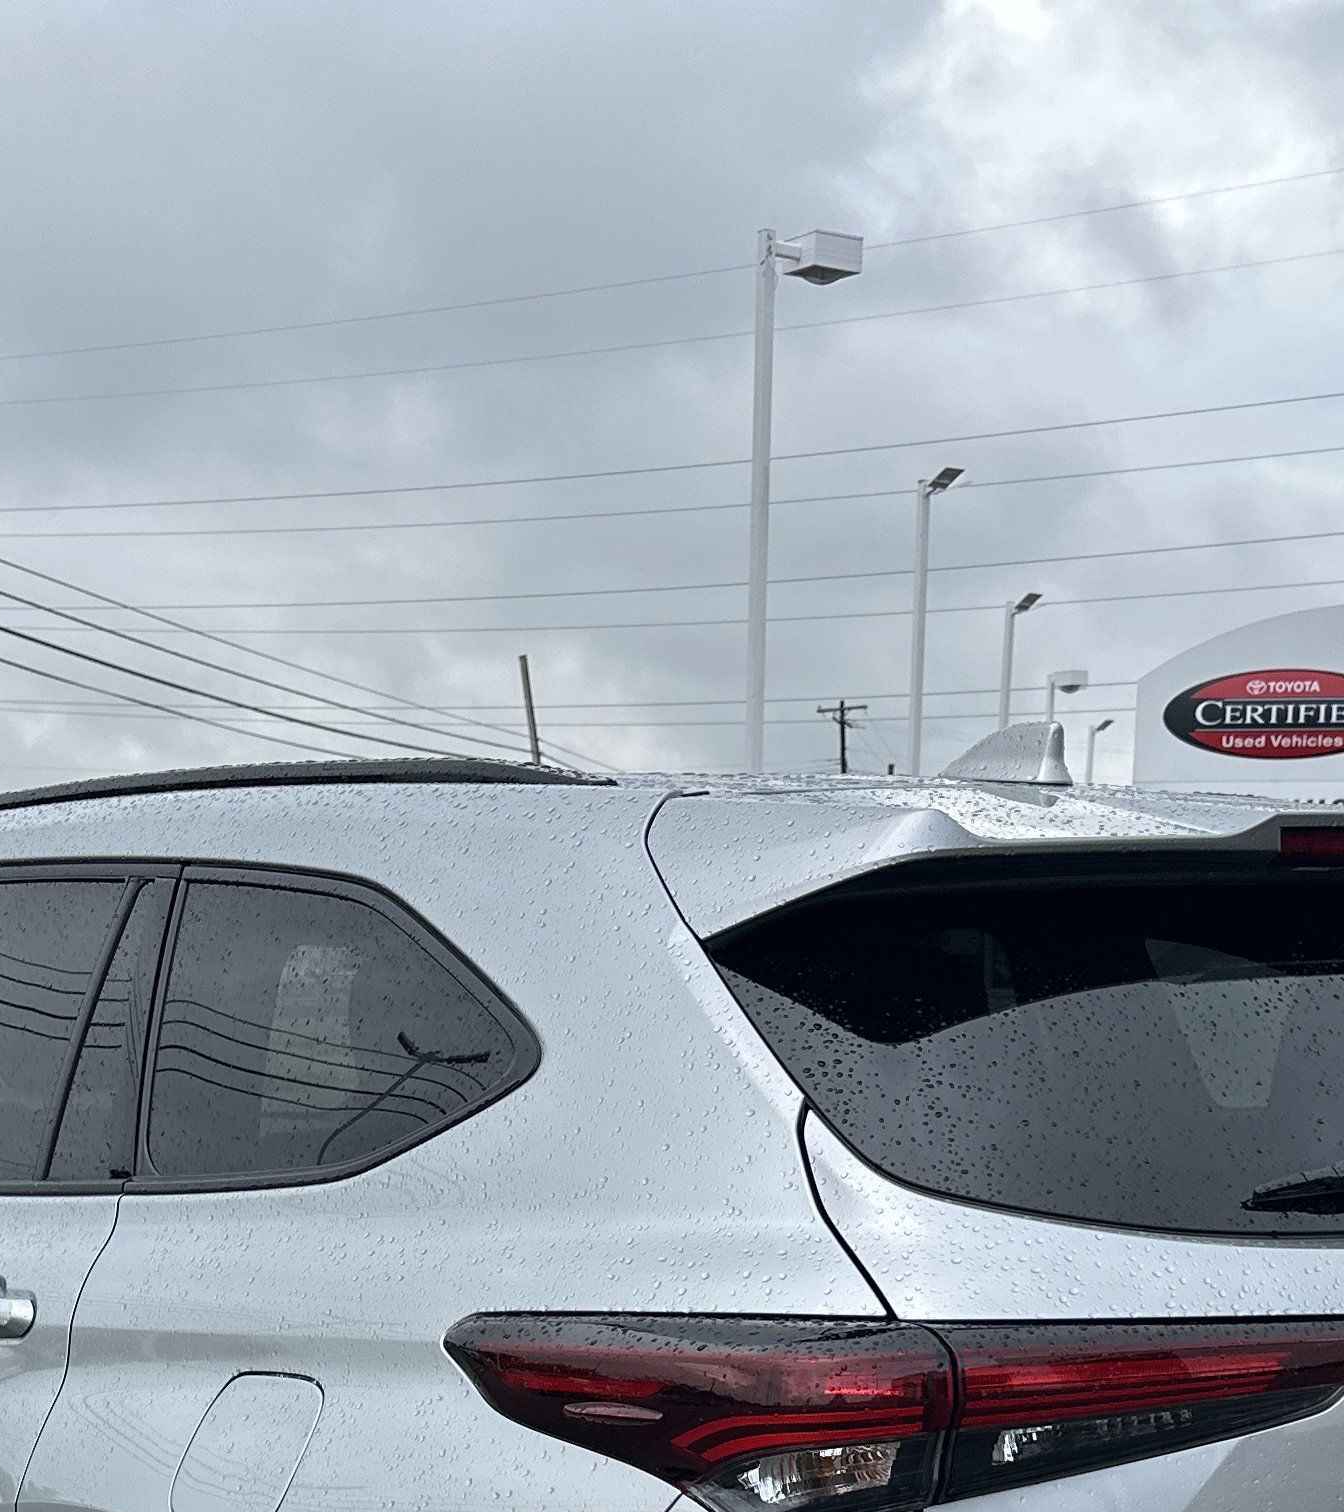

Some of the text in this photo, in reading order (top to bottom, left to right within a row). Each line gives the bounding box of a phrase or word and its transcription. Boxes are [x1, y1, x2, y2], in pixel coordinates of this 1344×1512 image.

[1268, 680, 1320, 693] TOYOTA
[1221, 734, 1344, 749] Used Vehicles
